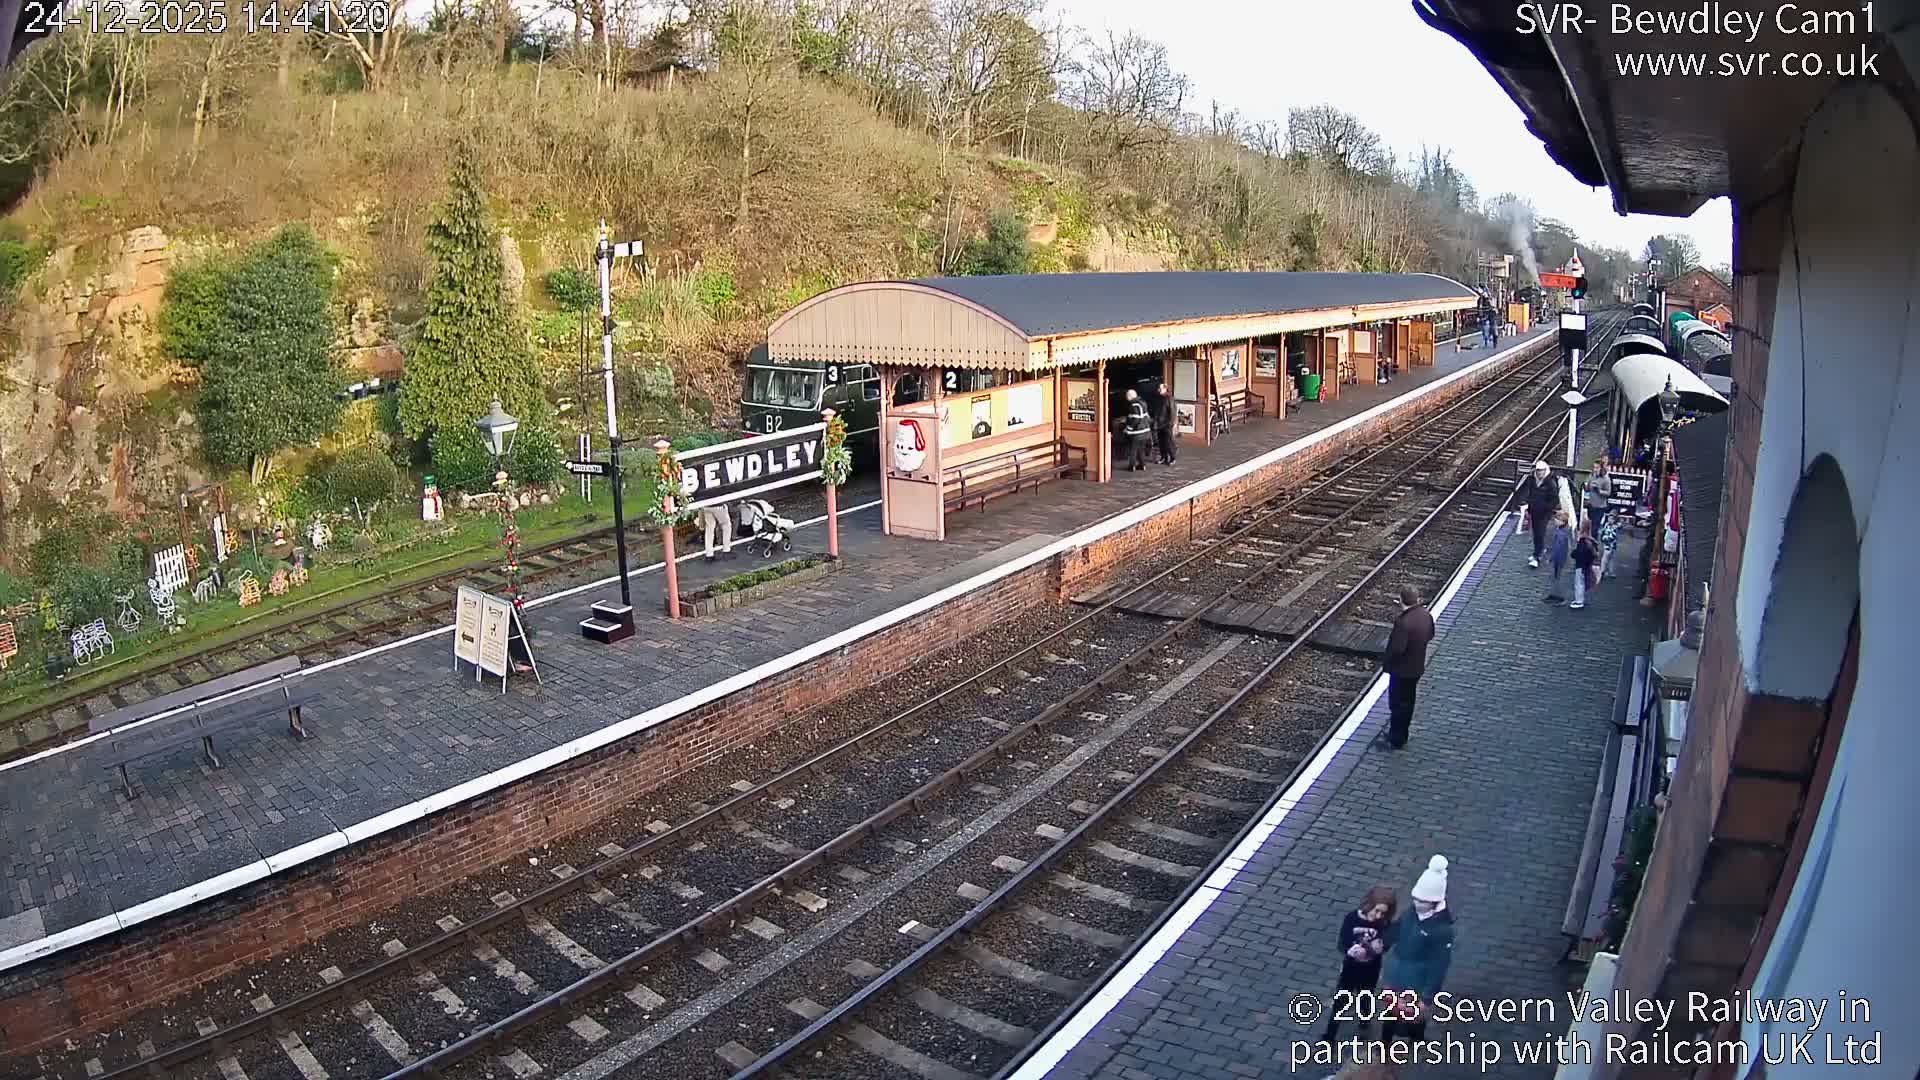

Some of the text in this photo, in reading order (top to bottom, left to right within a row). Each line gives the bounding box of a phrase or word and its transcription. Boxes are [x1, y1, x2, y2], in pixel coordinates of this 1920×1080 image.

[828, 365, 838, 382] 3
[945, 371, 957, 389] 2
[681, 440, 817, 494] BEWDLEY
